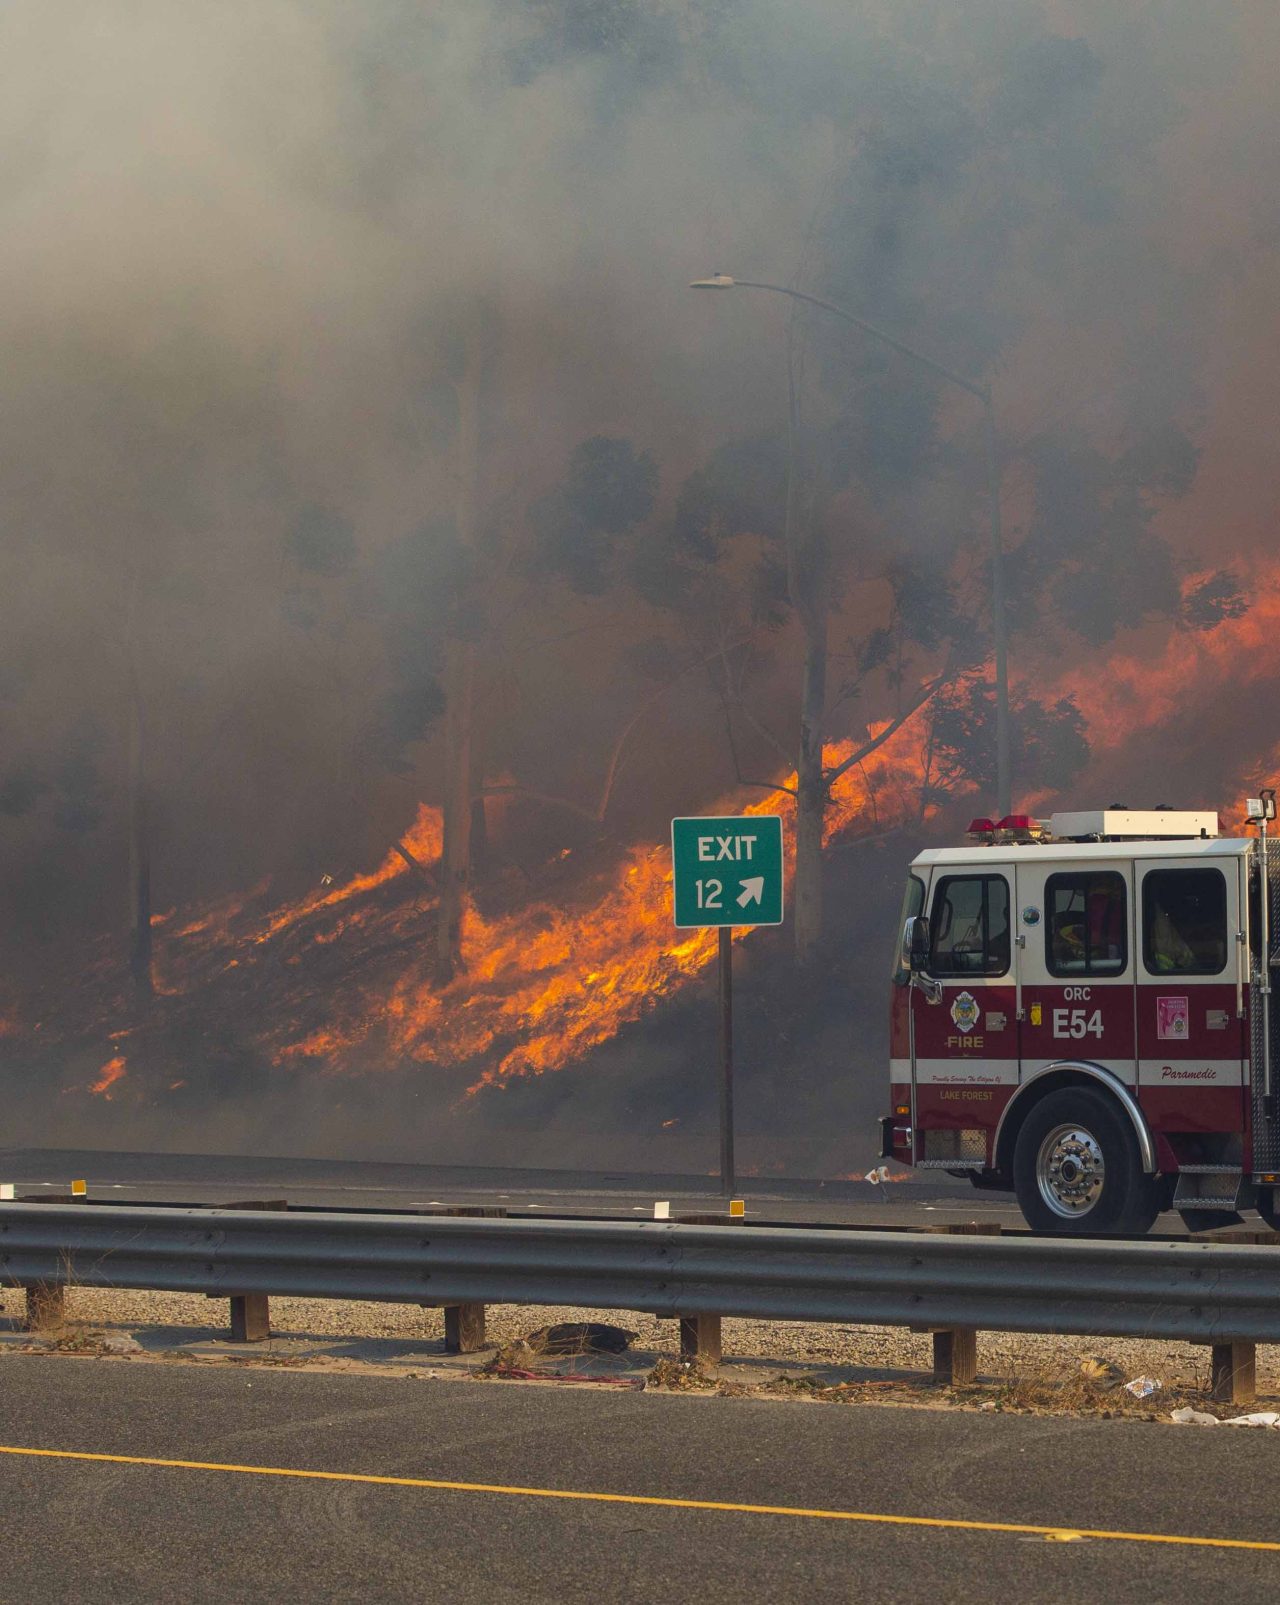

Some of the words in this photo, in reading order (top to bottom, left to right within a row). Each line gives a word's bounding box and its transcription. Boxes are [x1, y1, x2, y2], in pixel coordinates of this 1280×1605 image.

[698, 835, 757, 861] EXIT
[695, 879, 723, 909] 12
[1063, 987, 1091, 1001] ORC
[1053, 1008, 1104, 1039] E54
[947, 1036, 984, 1048] FIRE
[1161, 1066, 1217, 1080] Paramedic
[940, 1090, 960, 1100] LAKE
[961, 1090, 993, 1101] FOREST
